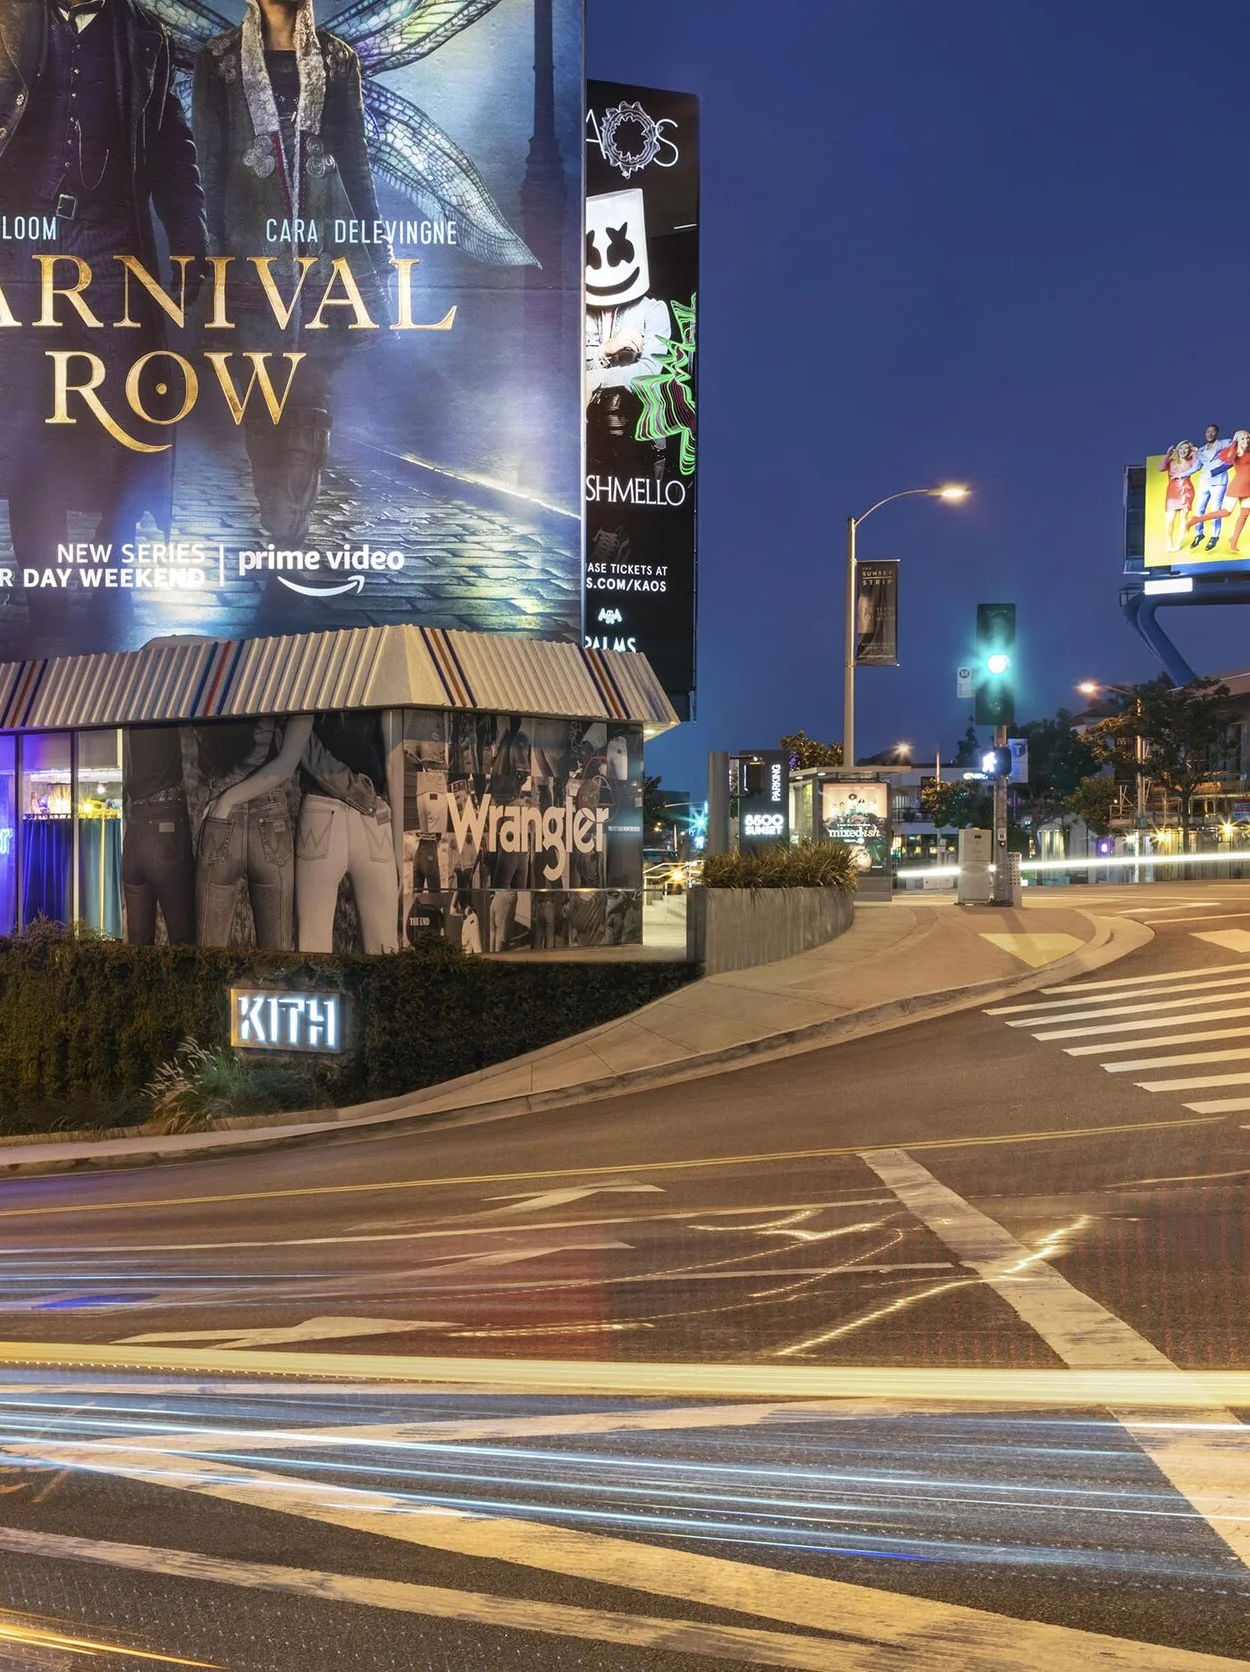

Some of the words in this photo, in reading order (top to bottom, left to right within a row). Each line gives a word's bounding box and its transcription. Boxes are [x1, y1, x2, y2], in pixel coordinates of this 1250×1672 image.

[266, 218, 318, 244] CARA
[334, 219, 457, 246] DELEVINGNE
[44, 350, 307, 453] ROW
[57, 543, 113, 564] NEW
[121, 543, 206, 564] SERIES
[239, 544, 320, 576] prime
[326, 543, 405, 571] video
[23, 567, 72, 588] DAY
[80, 567, 206, 589] WEEKEND
[585, 563, 607, 574] ASE
[610, 563, 653, 576] TICKETS
[656, 565, 668, 577] AT
[586, 578, 667, 592] S.COM/KAOS
[771, 764, 781, 801] PARKING
[744, 825, 783, 835] SUNSET
[745, 814, 784, 826] 8500
[446, 792, 610, 881] Wrangler
[828, 826, 881, 837] mixed-ish
[238, 996, 335, 1047] KITH
